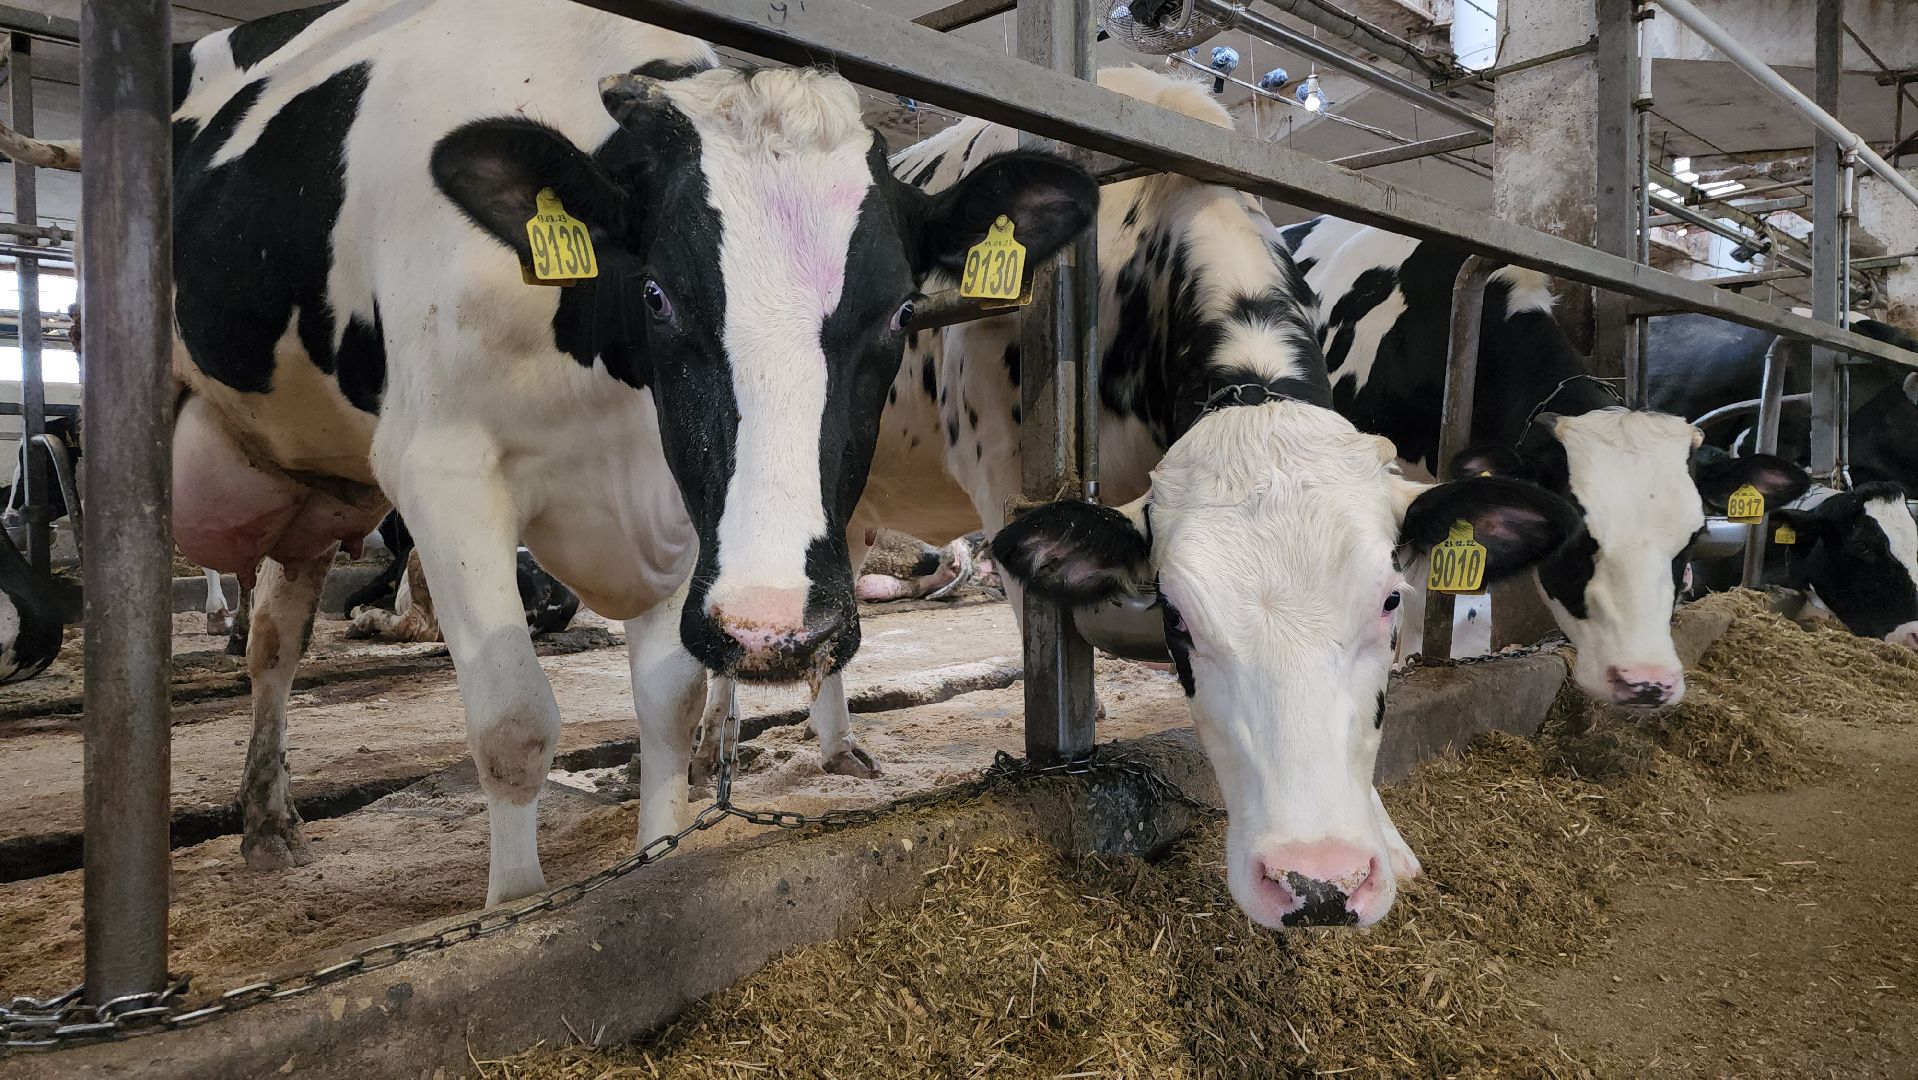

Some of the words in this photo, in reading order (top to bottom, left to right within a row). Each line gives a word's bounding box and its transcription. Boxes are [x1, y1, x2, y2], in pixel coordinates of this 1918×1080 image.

[532, 224, 592, 276] 9130
[964, 249, 1018, 296] 9130
[1730, 498, 1762, 516] 8917
[1431, 549, 1481, 588] 9010
